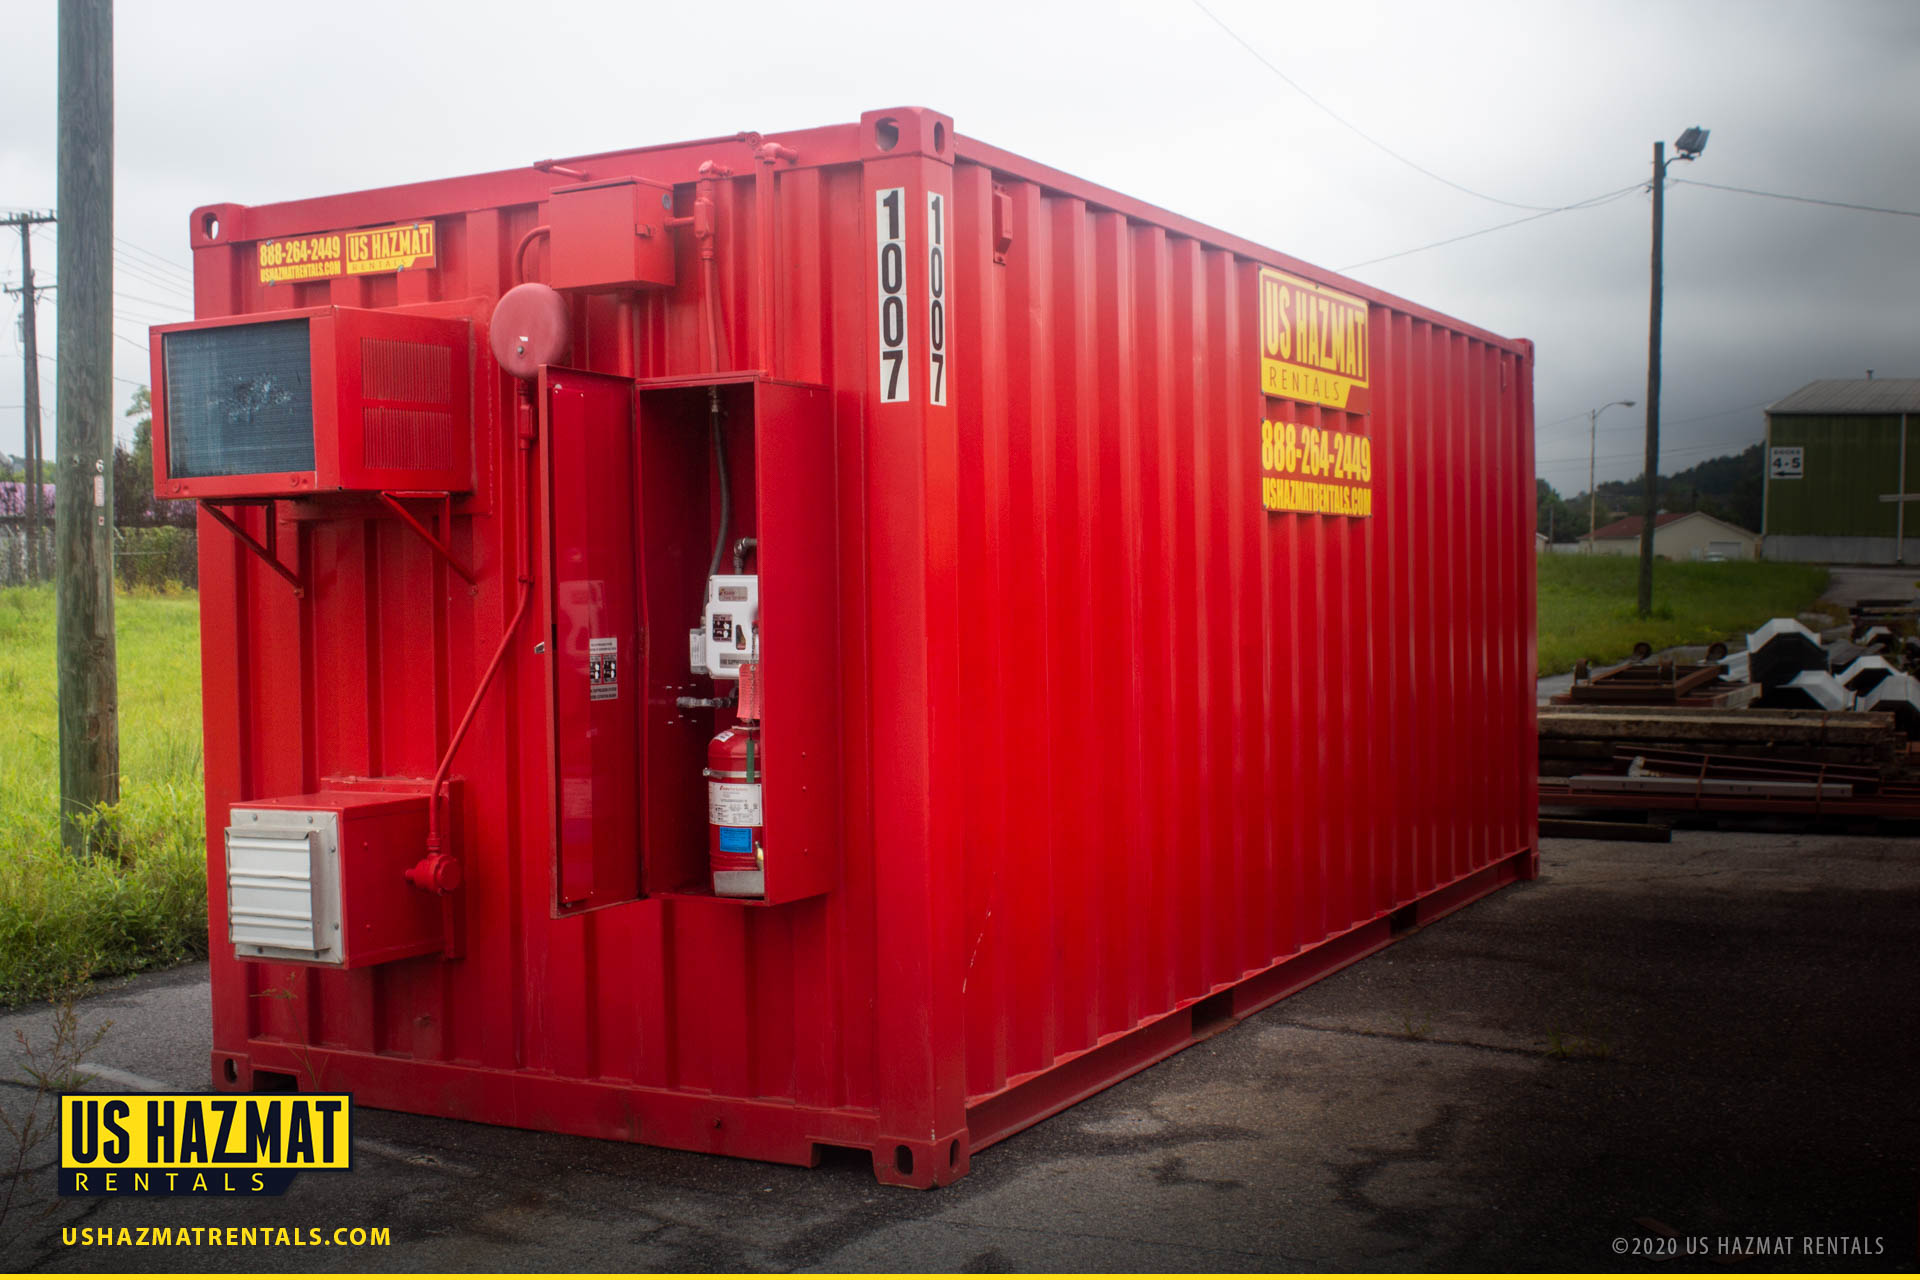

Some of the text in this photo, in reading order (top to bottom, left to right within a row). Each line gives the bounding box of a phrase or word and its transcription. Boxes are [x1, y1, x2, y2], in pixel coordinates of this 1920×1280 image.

[260, 236, 341, 266] 888-264-2449
[350, 228, 429, 261] US HAZMAT
[260, 260, 341, 283] USHAZMATRENTALS.COM
[880, 189, 904, 400] 1007
[931, 195, 944, 403] 1007
[1266, 281, 1365, 378] US HAZMAT
[1269, 366, 1339, 401] RENTALS
[1262, 420, 1371, 482] 888-264-2449
[1262, 477, 1371, 516] USHAZMATRENTALS.COM
